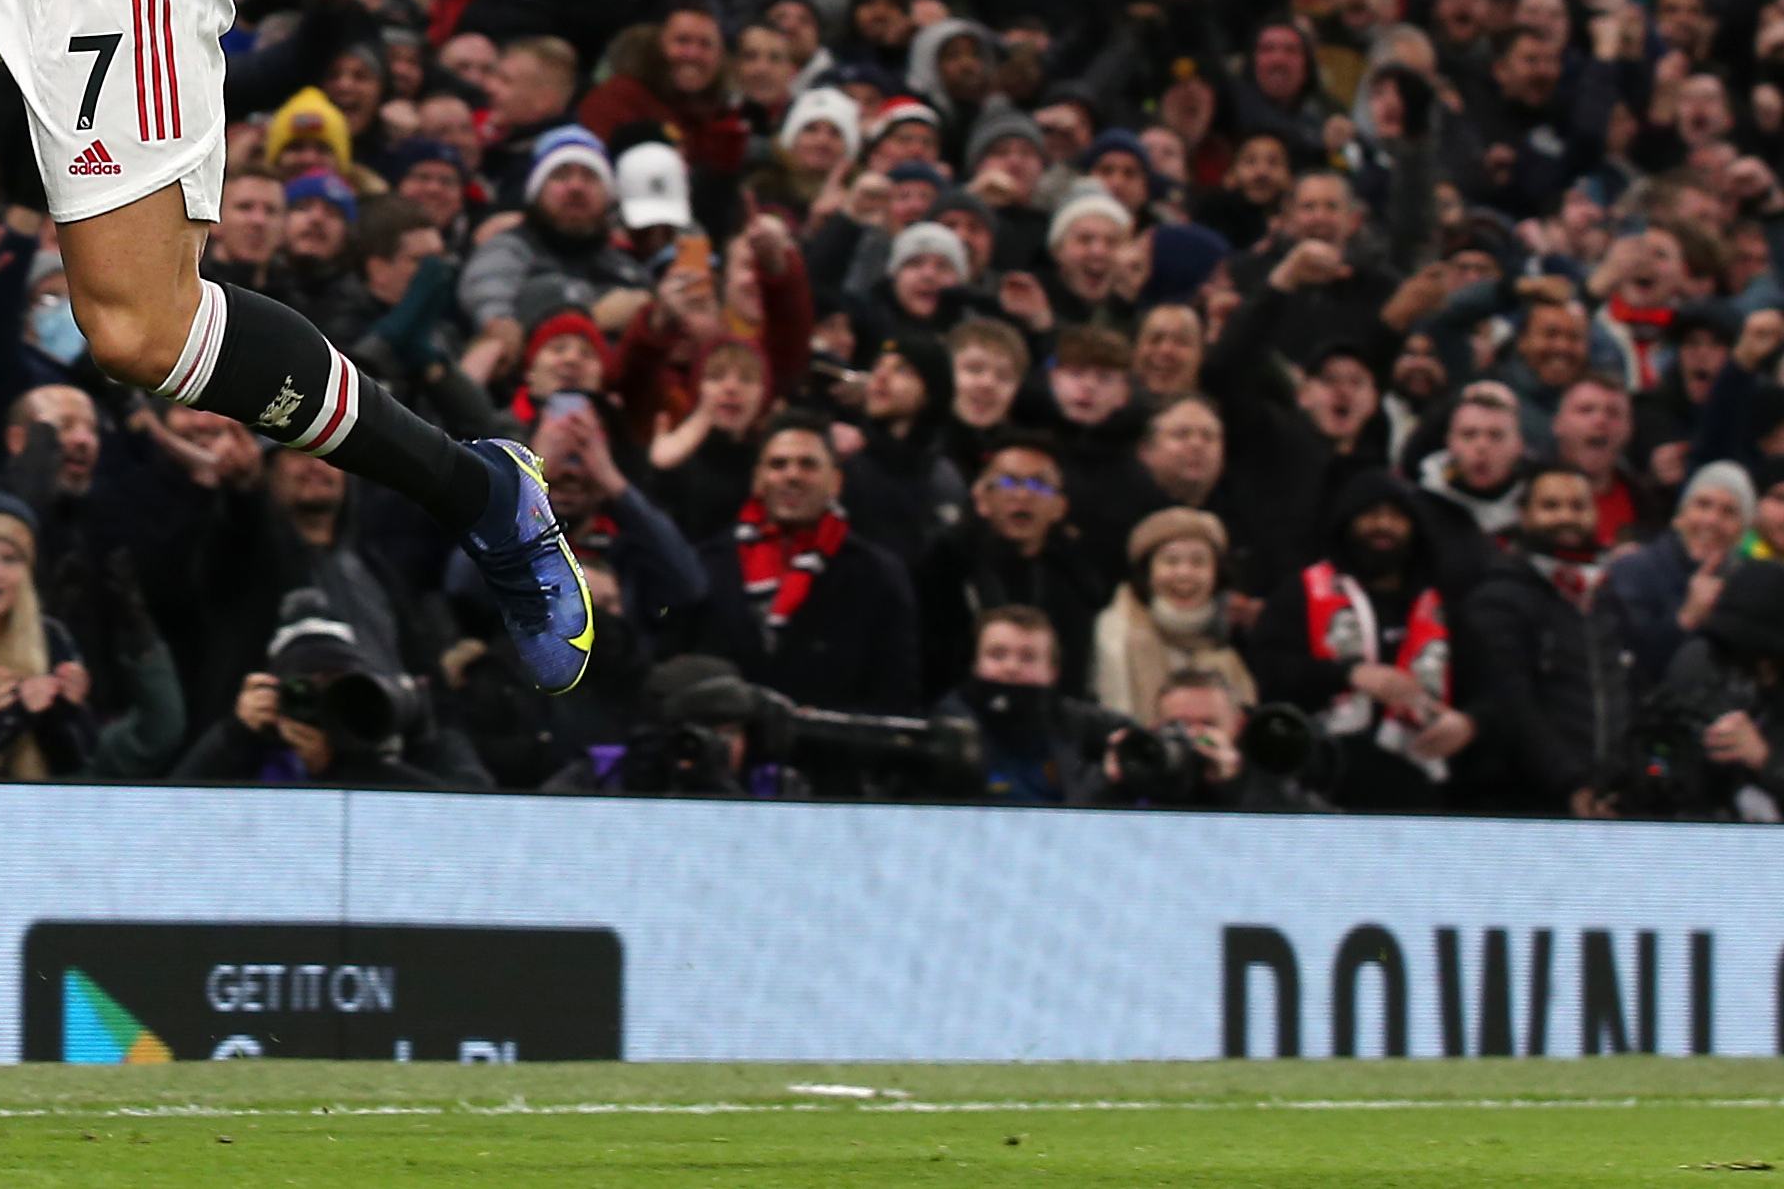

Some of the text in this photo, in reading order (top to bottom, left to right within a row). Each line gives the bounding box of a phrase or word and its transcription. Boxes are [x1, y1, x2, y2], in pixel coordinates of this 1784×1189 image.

[68, 33, 123, 130] 7
[68, 162, 122, 176] adidas
[206, 964, 397, 1012] GET IT ON
